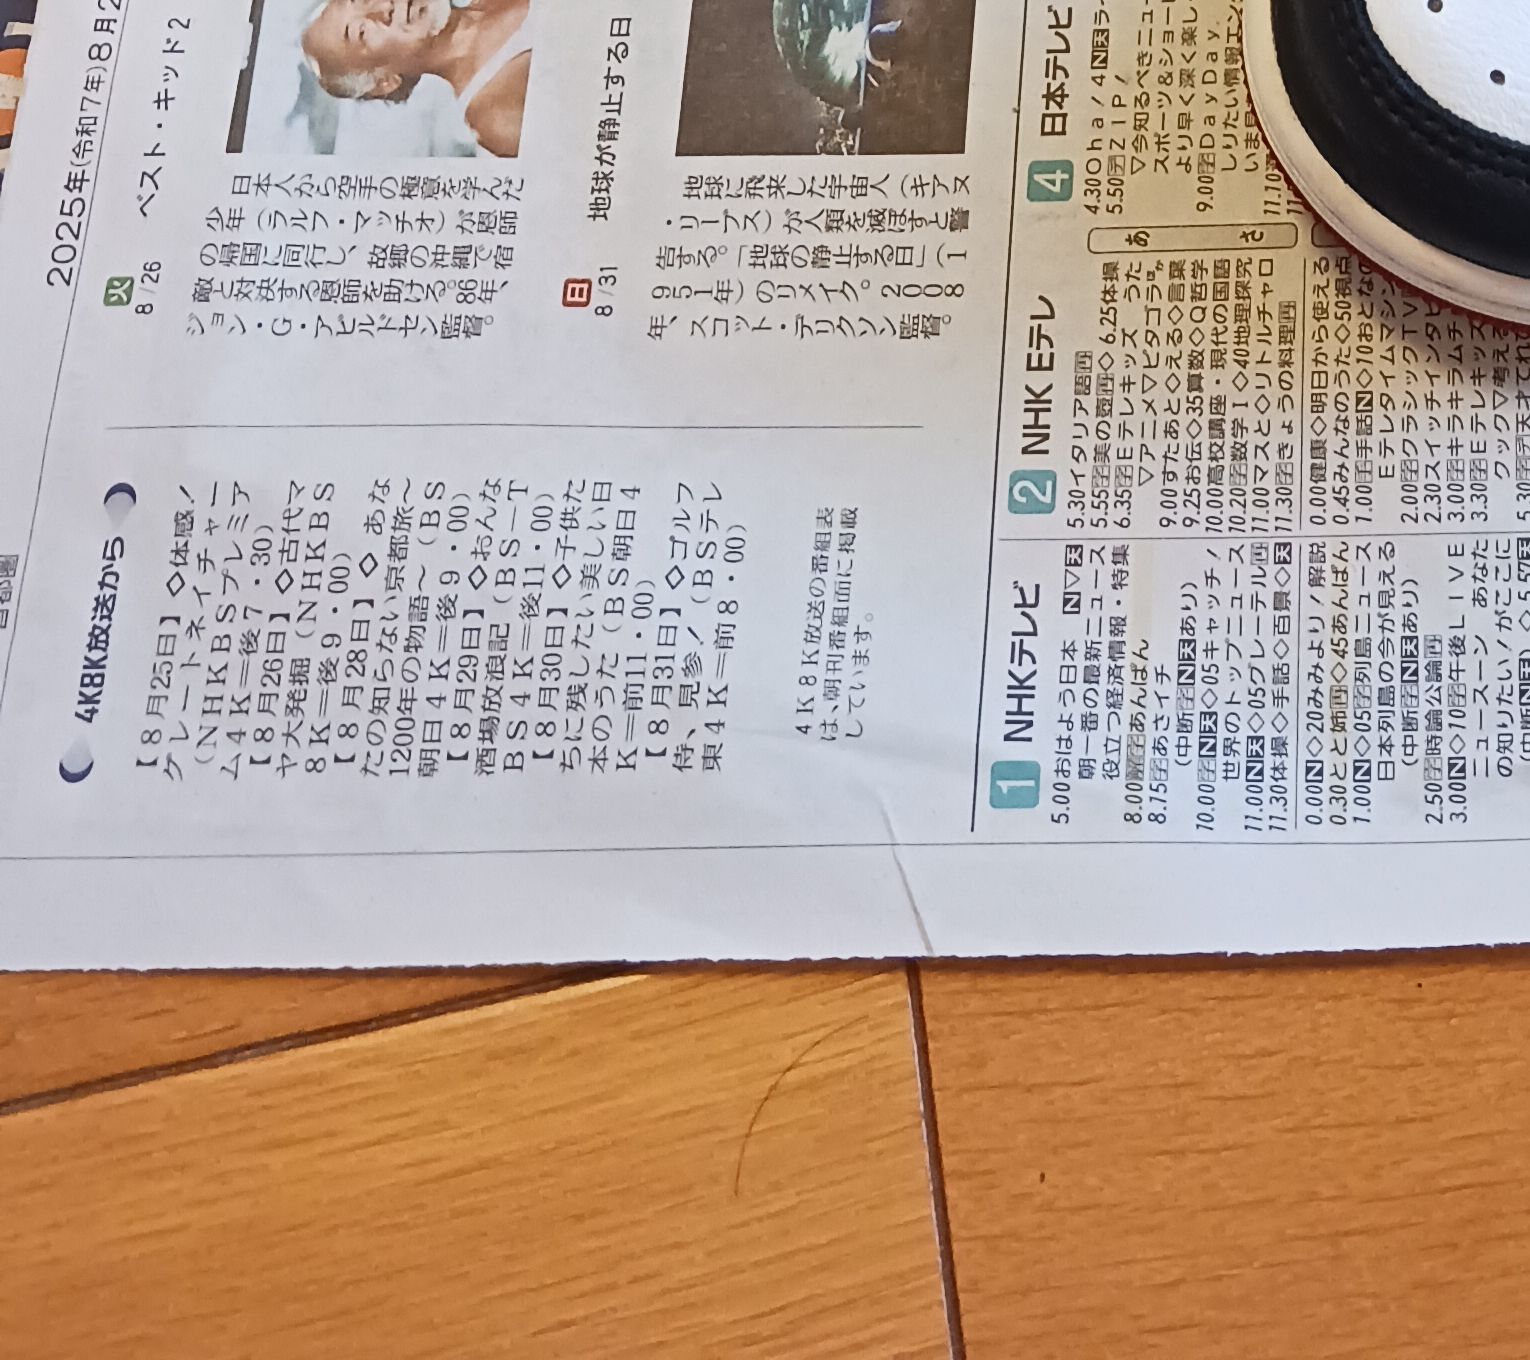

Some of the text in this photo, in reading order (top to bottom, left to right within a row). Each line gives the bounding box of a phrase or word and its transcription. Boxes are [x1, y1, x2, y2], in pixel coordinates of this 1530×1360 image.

[137, 18, 191, 217] ベスト・キッド2
[587, 17, 633, 221] 地球が静止する日
[1040, 6, 1072, 137] 日本テレビ
[200, 241, 514, 270] の帰国に同行し、故郷の沖縄で宿
[231, 173, 523, 203] 日本人から空手の極意を学んだ
[683, 174, 969, 200] 地球に飛来した宇宙人（キアヌ
[104, 277, 133, 306] 火
[562, 279, 592, 307] 日
[647, 314, 953, 340] 年、スコット・デリクソン監督。
[1022, 294, 1056, 456] NHK Eテレ
[75, 537, 124, 723] 4K8K放送から
[560, 481, 612, 771] ちに残したい美しい日
[795, 507, 834, 736] 4K8K放送の番組表
[845, 612, 874, 738] しています。
[1004, 581, 1041, 742] NHKテレビ
[1078, 545, 1106, 780] 朝一番の最新ニュース
[1104, 544, 1129, 780] 役立つ経済情報・特集
[1222, 544, 1246, 781] 世界のトップニュース
[1377, 541, 1397, 780] 日本列島の今が見える
